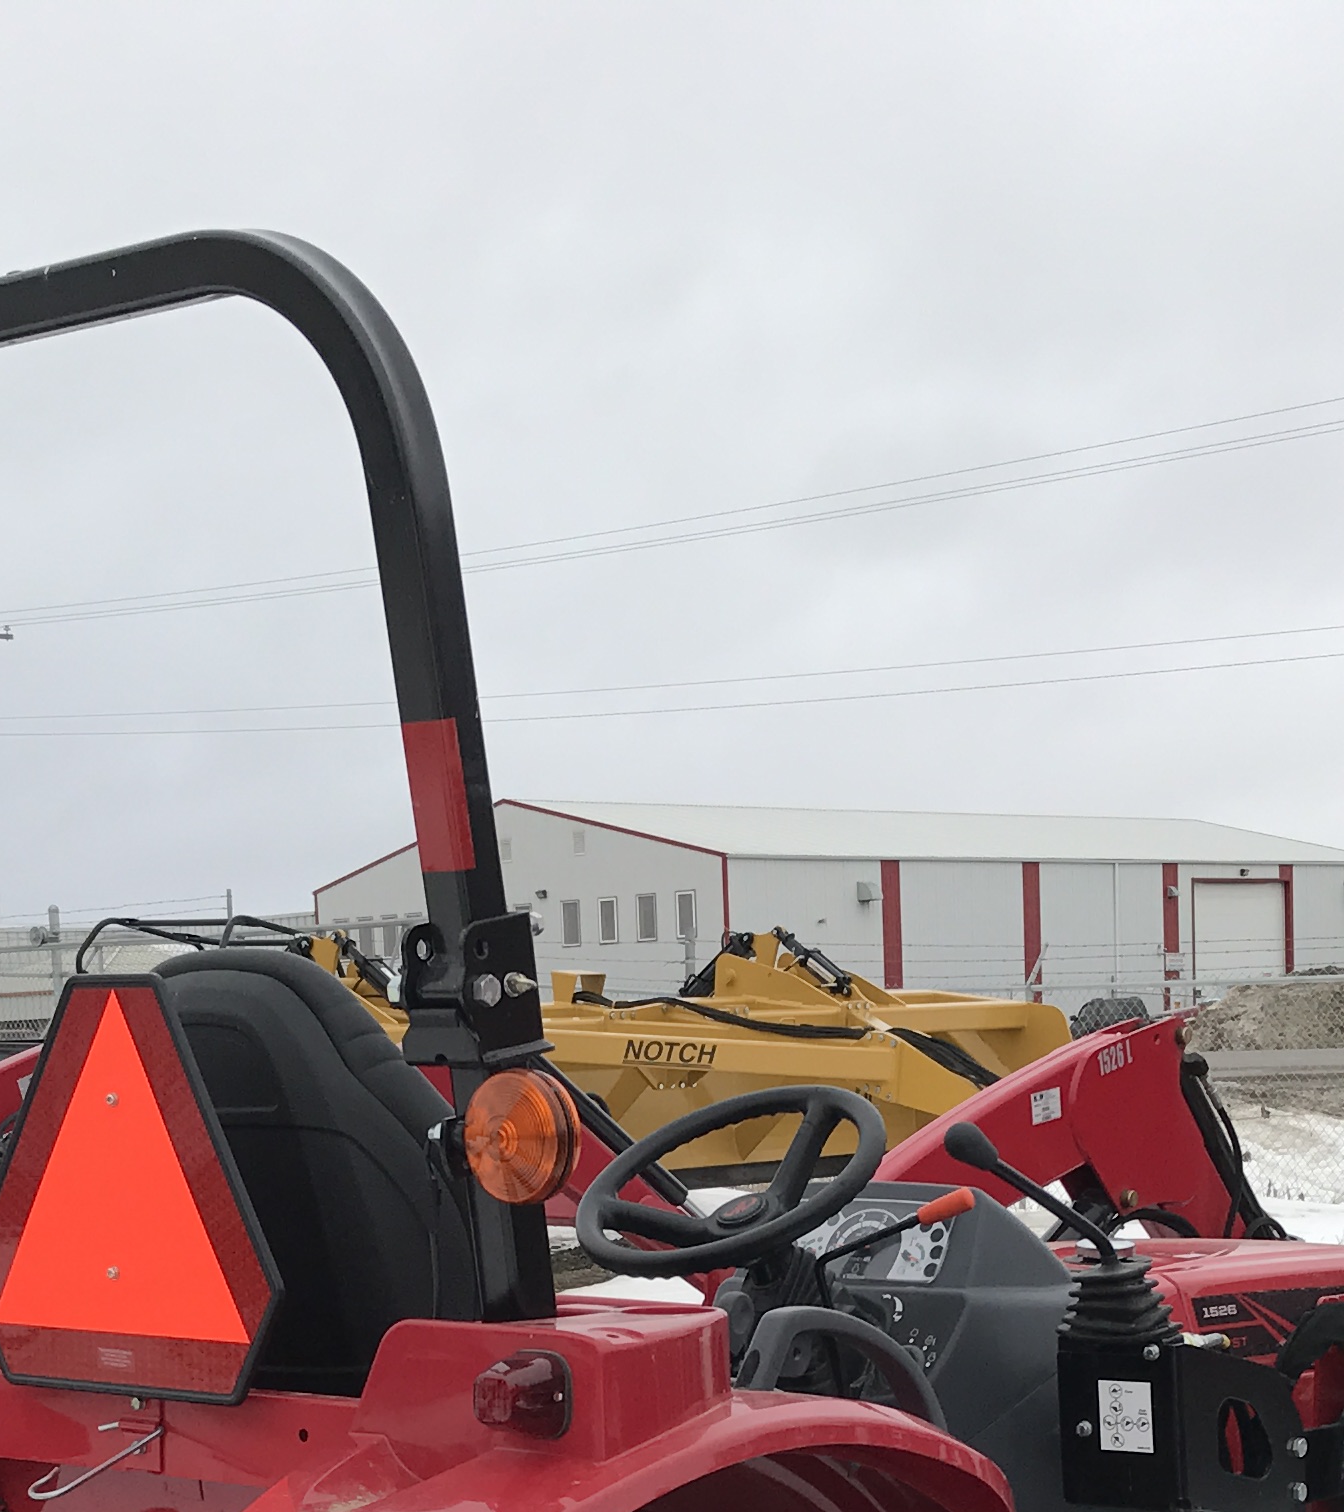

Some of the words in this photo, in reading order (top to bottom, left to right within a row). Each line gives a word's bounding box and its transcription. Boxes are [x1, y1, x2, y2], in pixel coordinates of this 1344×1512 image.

[623, 1039, 718, 1064] NOTCH
[1097, 1042, 1125, 1077] 1526
[1202, 1304, 1238, 1319] 1526
